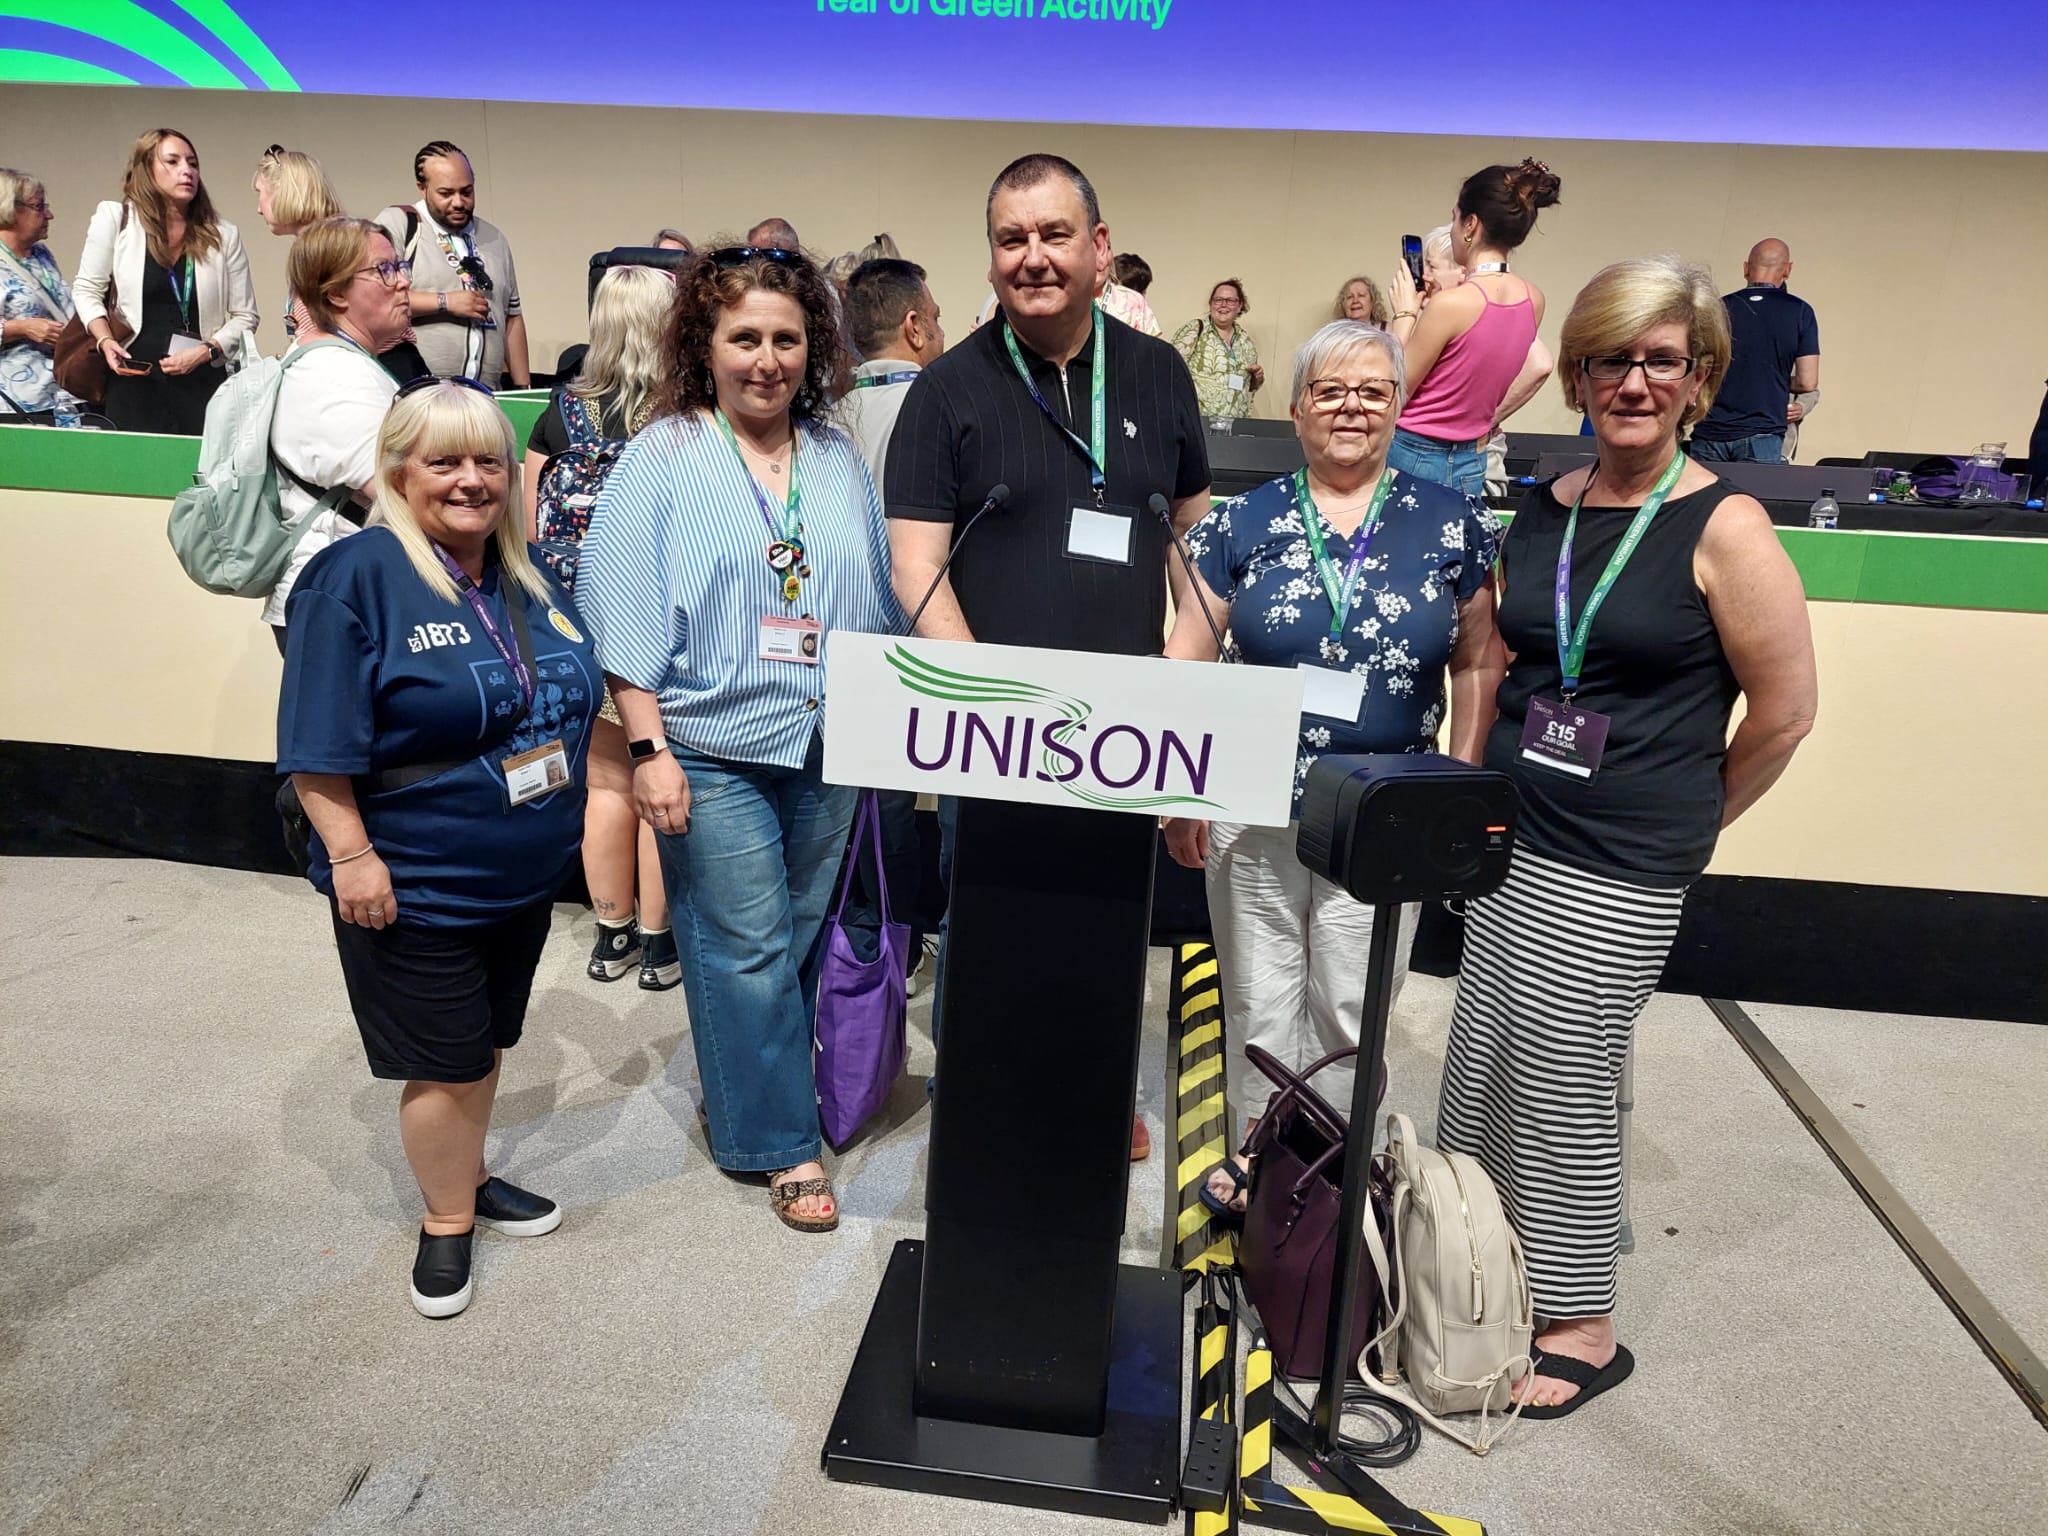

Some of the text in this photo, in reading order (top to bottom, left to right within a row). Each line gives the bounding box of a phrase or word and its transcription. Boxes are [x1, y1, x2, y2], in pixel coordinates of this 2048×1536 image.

[929, 0, 1034, 18] Green
[1040, 0, 1174, 31] Activity
[1614, 515, 1648, 566] GREEN UNISON
[1560, 620, 1569, 646] GREEN
[1576, 592, 1602, 646] GREEN UNISON
[407, 632, 423, 653] EST.
[413, 621, 472, 650] 1873
[1541, 734, 1577, 751] OUR GOAL
[1545, 720, 1577, 742] £15
[906, 706, 1213, 796] UNISON
